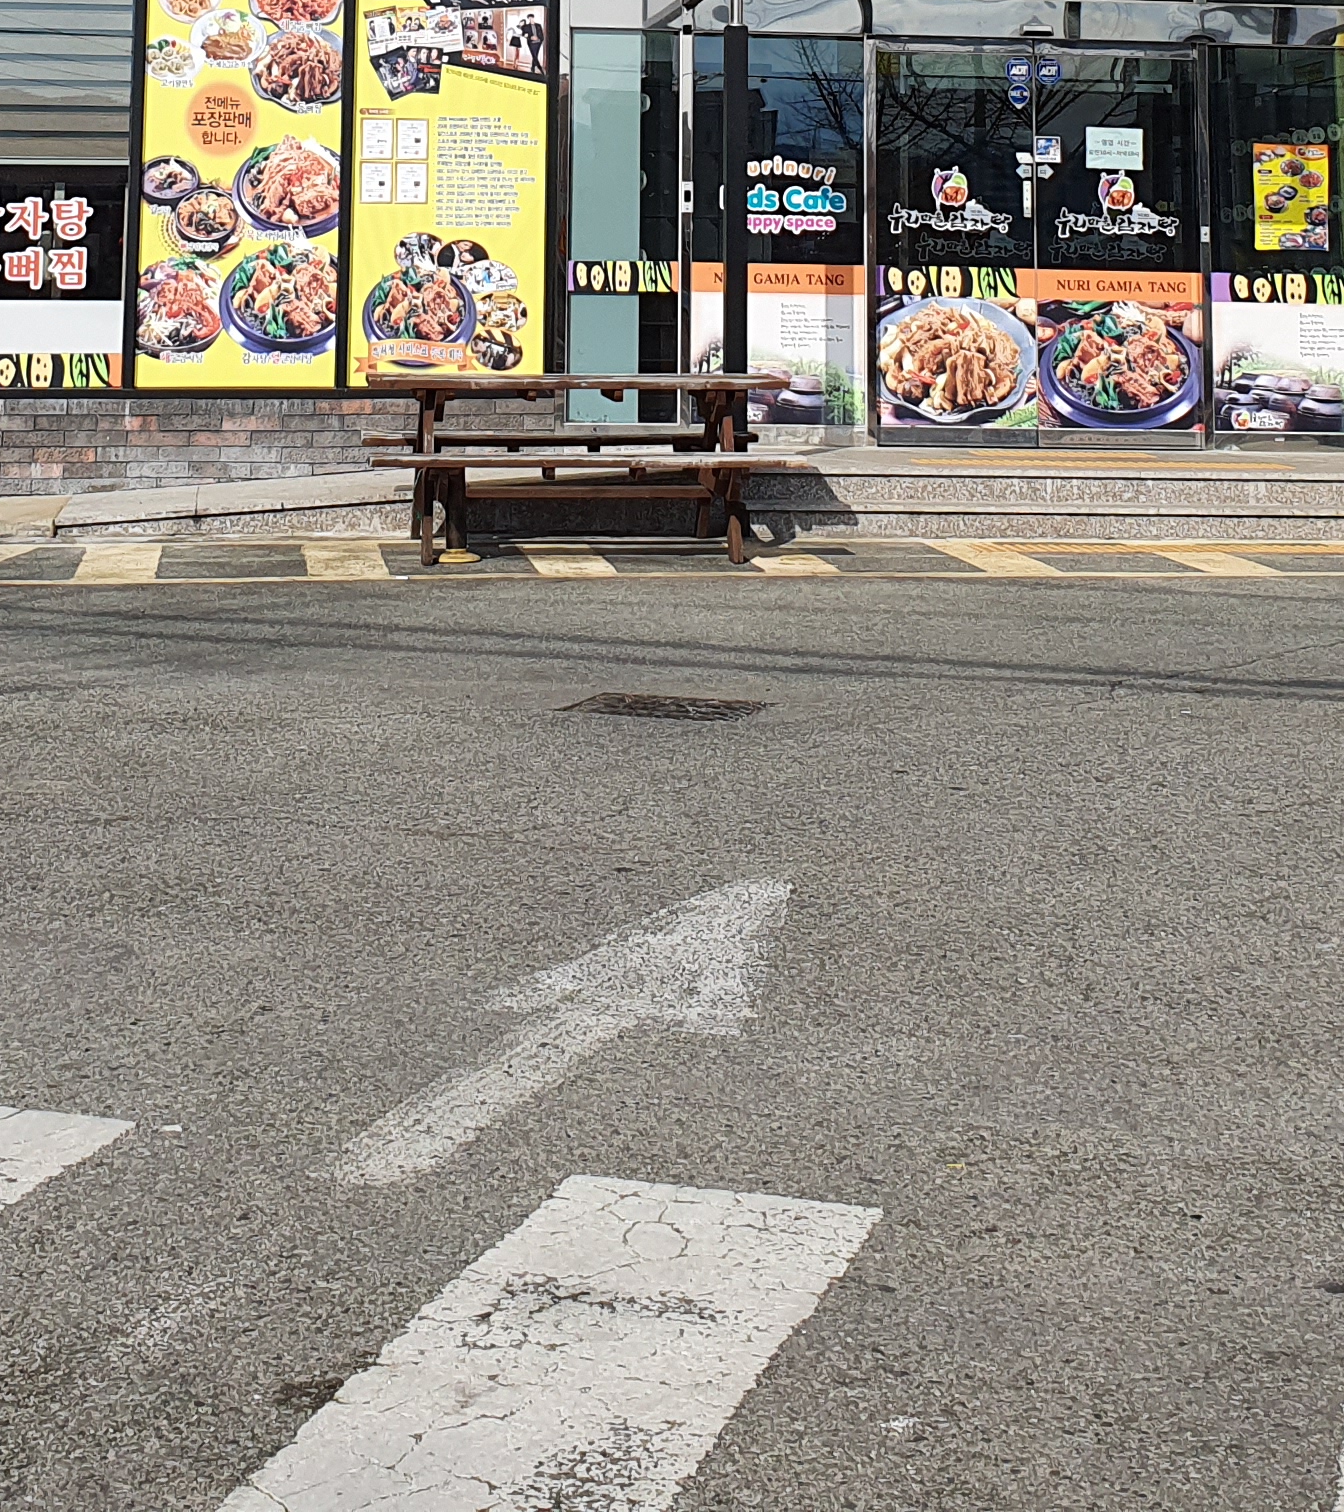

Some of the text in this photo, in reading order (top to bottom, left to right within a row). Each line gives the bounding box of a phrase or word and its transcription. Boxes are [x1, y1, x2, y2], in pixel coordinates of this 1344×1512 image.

[1010, 65, 1029, 76] ADT
[1039, 66, 1058, 76] ADT
[204, 96, 242, 110] 전메뉴
[191, 111, 252, 129] 포장판매
[747, 157, 836, 184] urinuri
[784, 187, 846, 211] Cafe
[786, 217, 835, 233] space
[752, 272, 846, 287] GAMJA TANG
[1055, 278, 1187, 294] NURI GAMJA TANG
